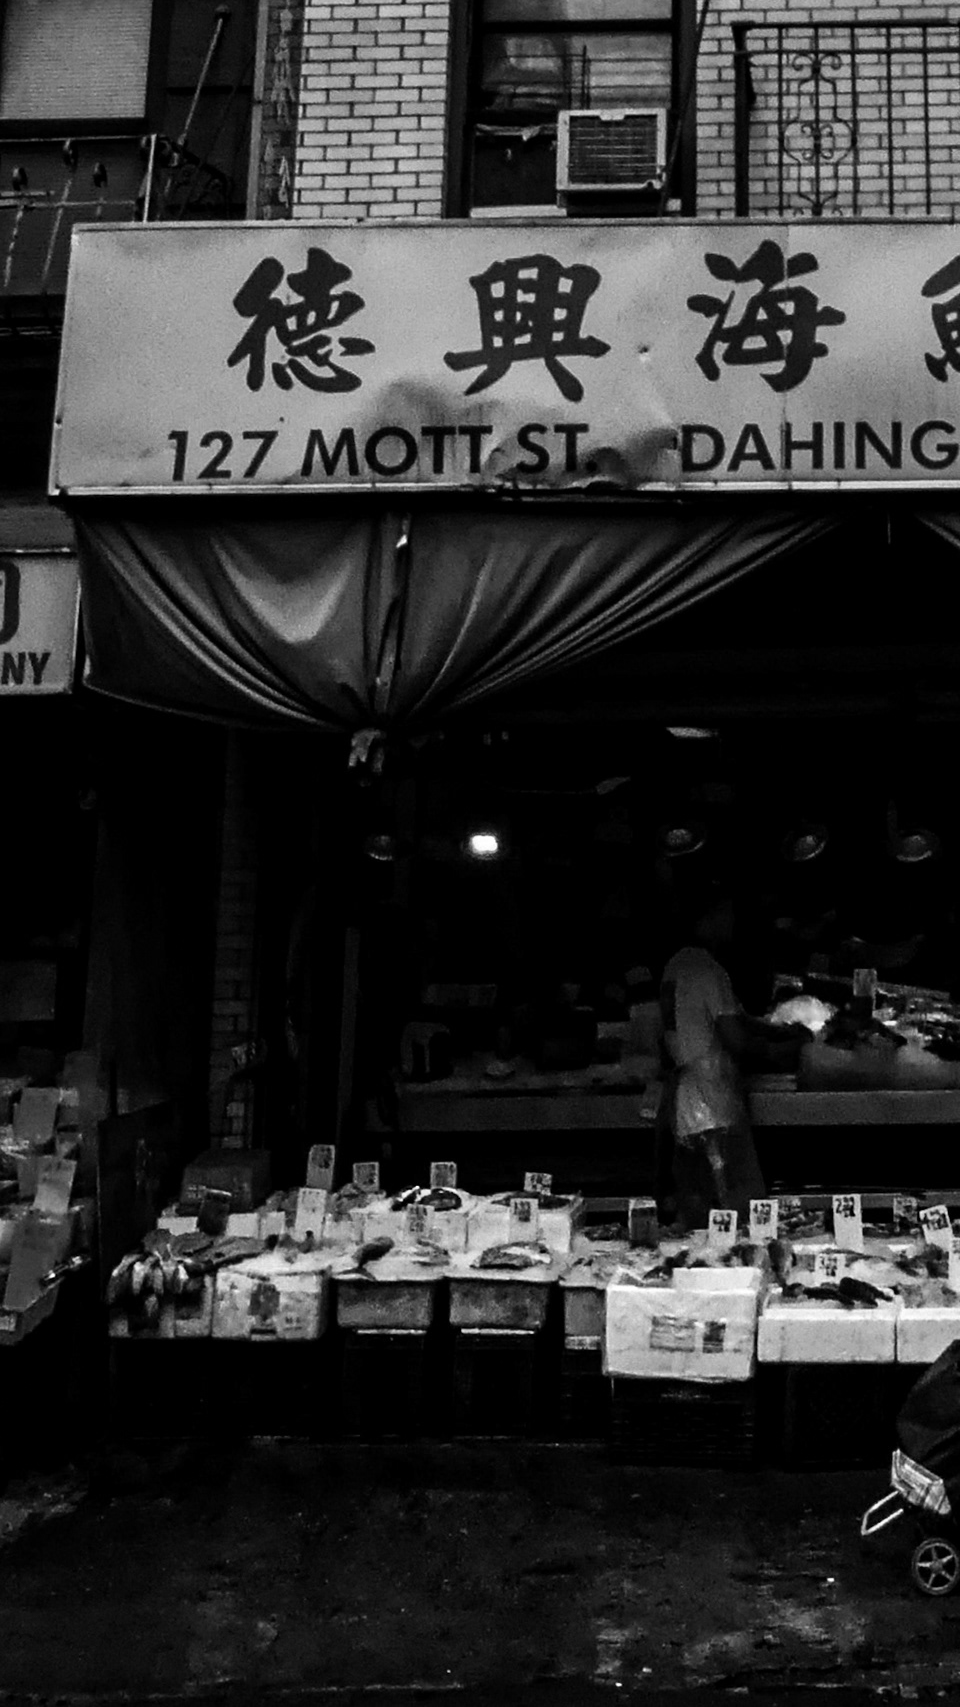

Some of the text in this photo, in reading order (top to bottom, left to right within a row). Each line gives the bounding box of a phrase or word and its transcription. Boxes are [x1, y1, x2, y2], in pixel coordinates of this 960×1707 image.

[168, 423, 599, 481] 127 MOTT ST.
[681, 420, 960, 473] DAHING
